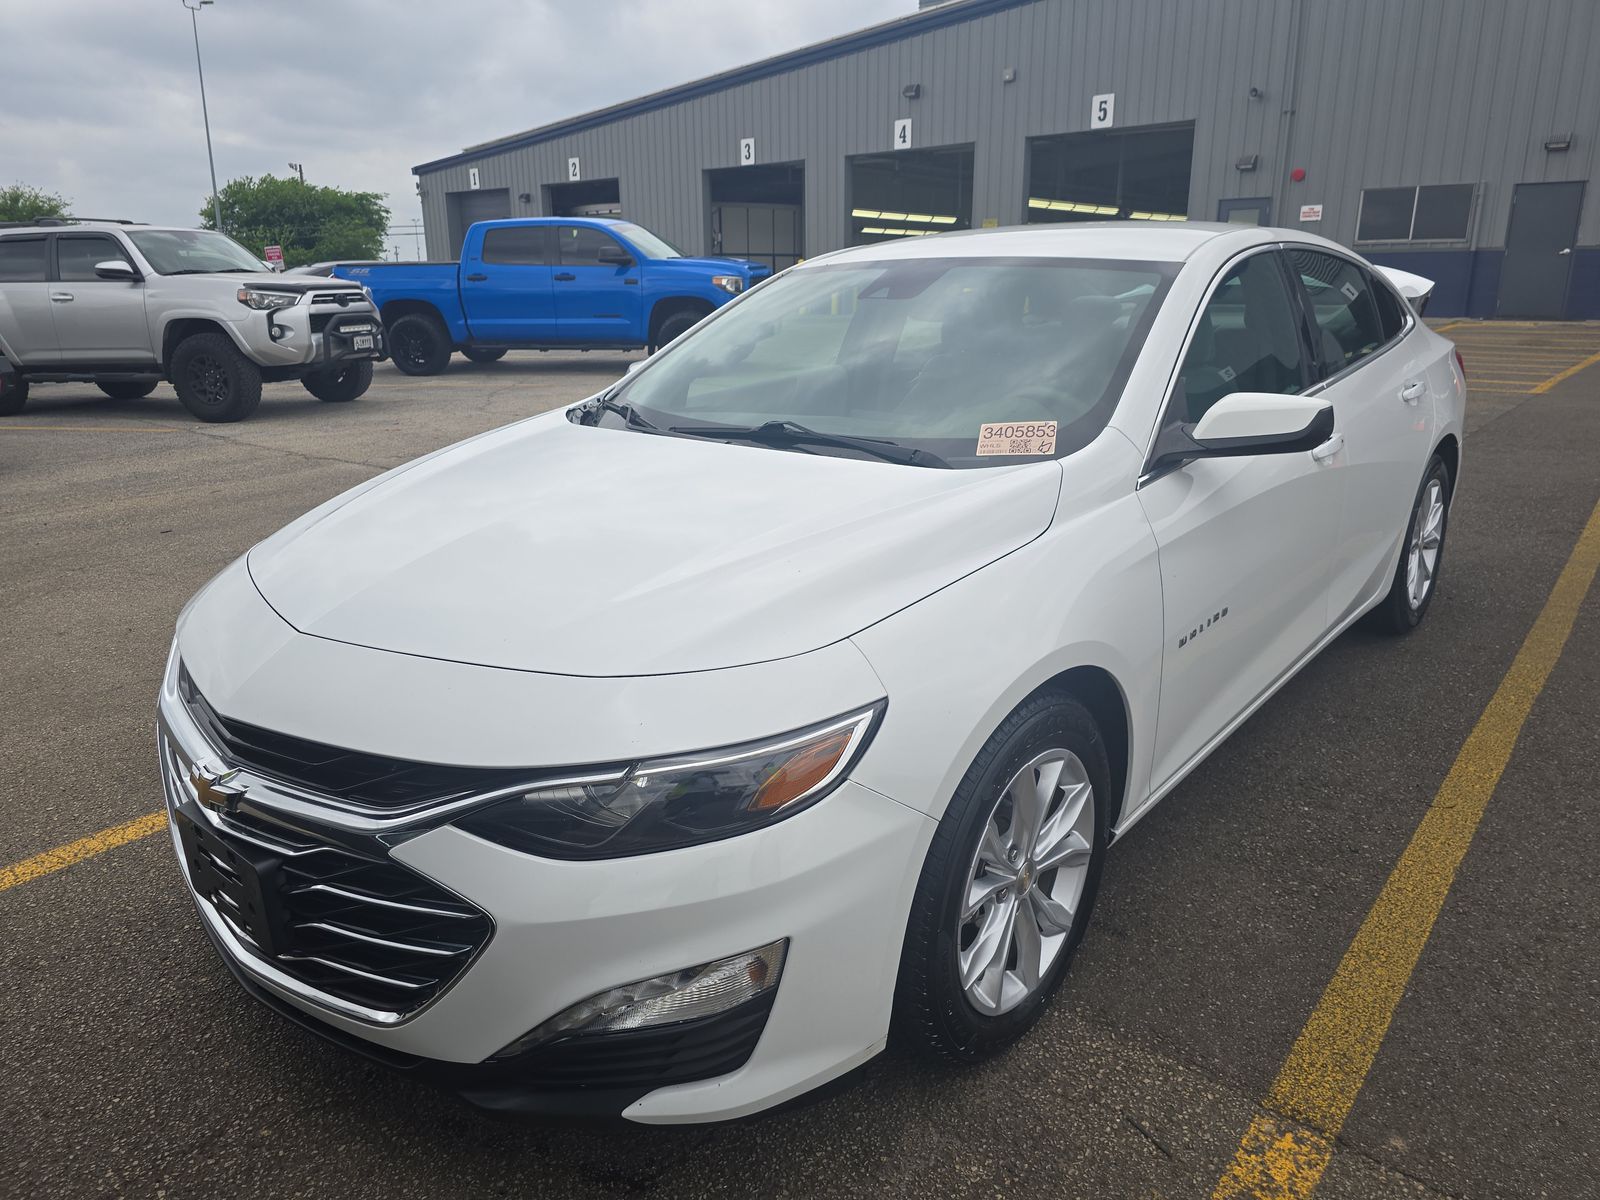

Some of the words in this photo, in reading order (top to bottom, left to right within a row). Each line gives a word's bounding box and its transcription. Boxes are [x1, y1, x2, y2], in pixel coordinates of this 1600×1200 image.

[1097, 100, 1108, 122] 5
[899, 124, 907, 144] 4
[744, 143, 751, 160] 3
[571, 161, 578, 177] 2
[472, 172, 477, 186] 1
[983, 424, 1056, 440] 3405853
